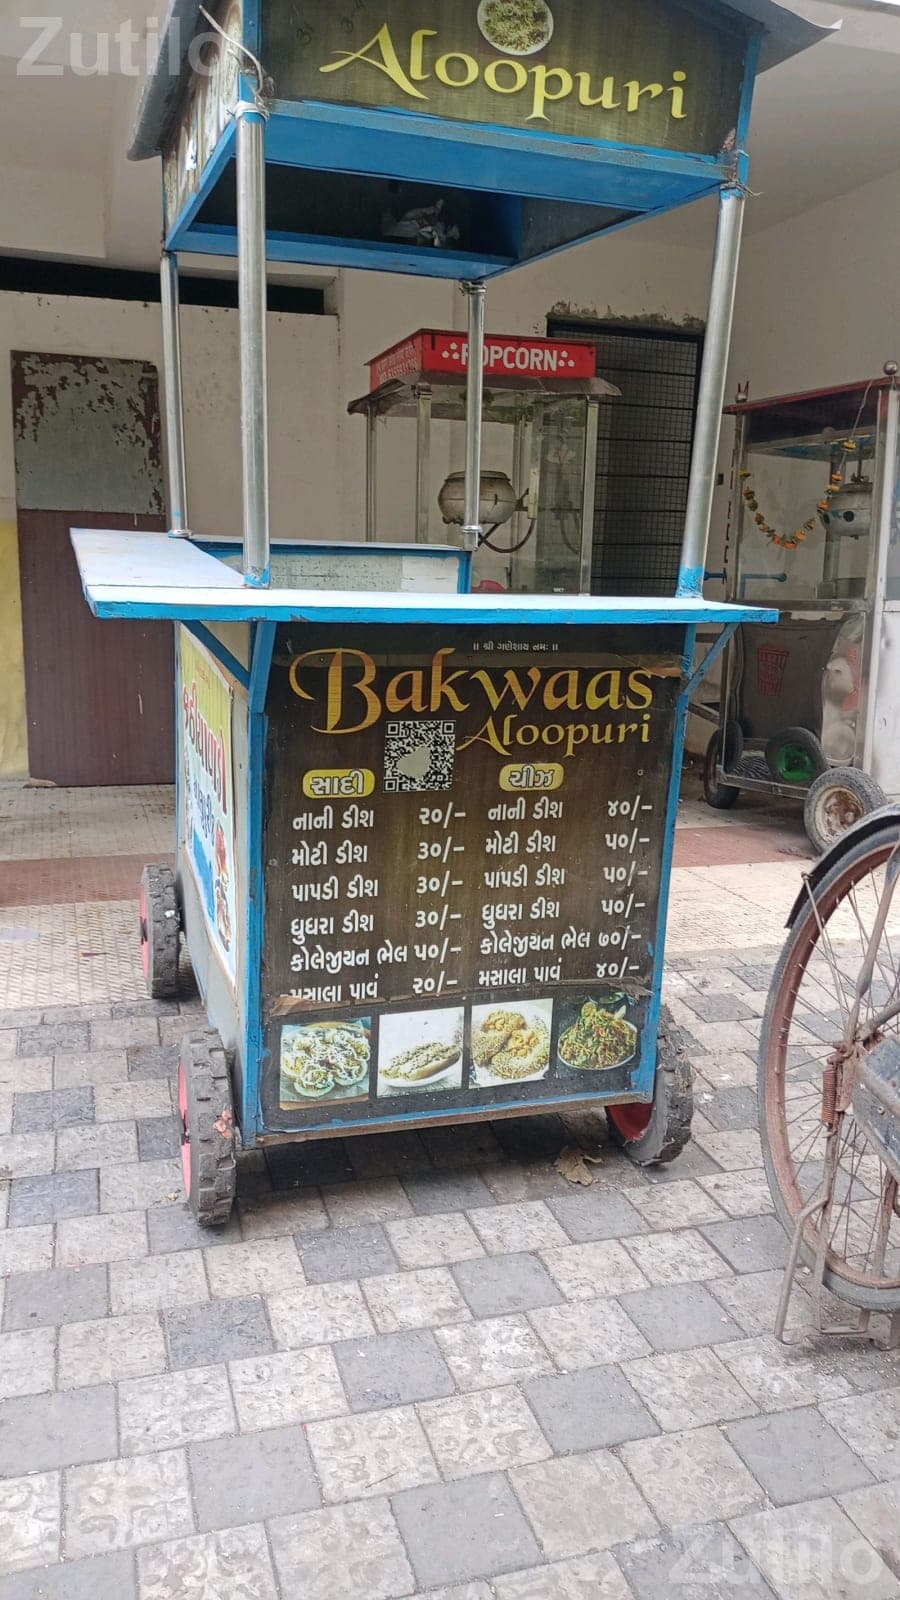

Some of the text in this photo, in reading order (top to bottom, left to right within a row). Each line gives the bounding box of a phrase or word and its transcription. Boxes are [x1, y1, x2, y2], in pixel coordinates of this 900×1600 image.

[319, 23, 688, 122] Aloopuri
[289, 647, 653, 734] Bakwaas
[456, 713, 651, 758] Aloopuri
[310, 769, 365, 796] સાદી
[508, 764, 555, 789] ચીઝ
[292, 804, 334, 831] નાની
[341, 804, 375, 829] ડીશ
[487, 797, 527, 821] નાની
[532, 796, 563, 819] ડીશ
[291, 840, 328, 867] મોટી
[335, 839, 368, 865] ડીશ
[485, 830, 519, 855] મોટી
[525, 829, 556, 853] ડીશ
[291, 875, 339, 902] પાપડી
[346, 873, 379, 899] ડીશ
[484, 863, 528, 889] પાપડી
[534, 862, 565, 886] ડીશ
[341, 909, 375, 934] ડીશ
[529, 896, 560, 920] ડીશ
[561, 925, 591, 950] ભેલ
[376, 938, 408, 965] ભેલ
[478, 967, 527, 987] મસાલા
